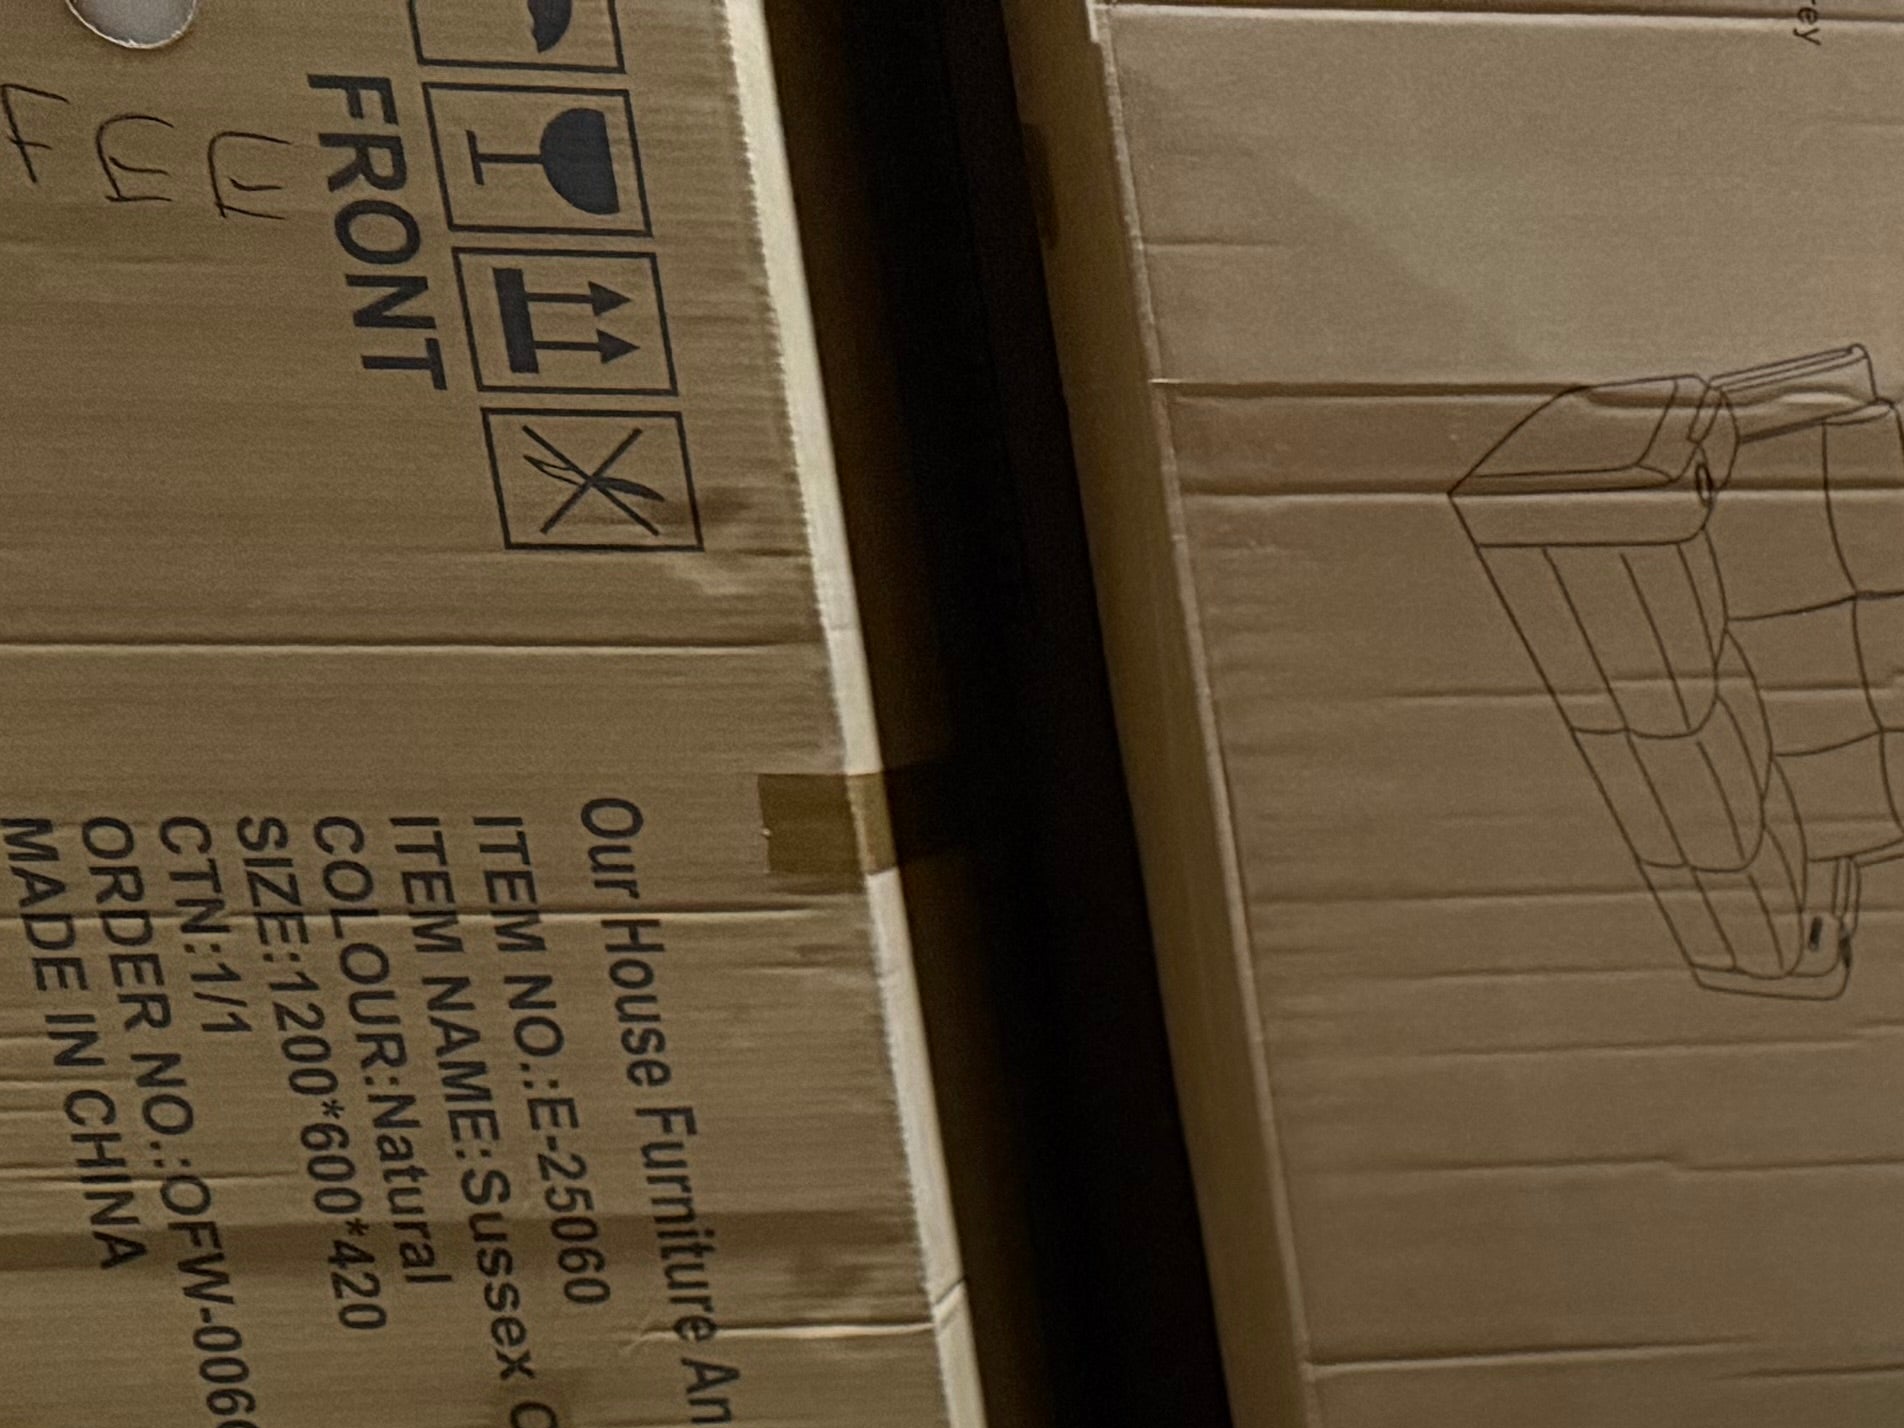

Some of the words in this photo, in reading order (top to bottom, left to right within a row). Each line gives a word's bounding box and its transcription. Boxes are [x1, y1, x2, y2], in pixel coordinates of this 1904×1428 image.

[1793, 0, 1821, 46] ey
[306, 73, 448, 391] FRONT
[0, 818, 89, 991] MADE
[82, 816, 171, 1031] ORDER
[159, 816, 252, 1032] CTN:1/1
[389, 816, 465, 952] ITEM
[473, 816, 547, 951] ITEM
[580, 797, 644, 900] Our
[45, 1014, 107, 1066] IN
[314, 816, 452, 1283] COLOUR:Natural
[601, 919, 671, 1087] House
[63, 1089, 148, 1270] CHINA
[422, 977, 535, 1380] NAME:Sussex
[504, 975, 611, 1305] NO.:E-25060
[635, 1106, 718, 1343] Furniture
